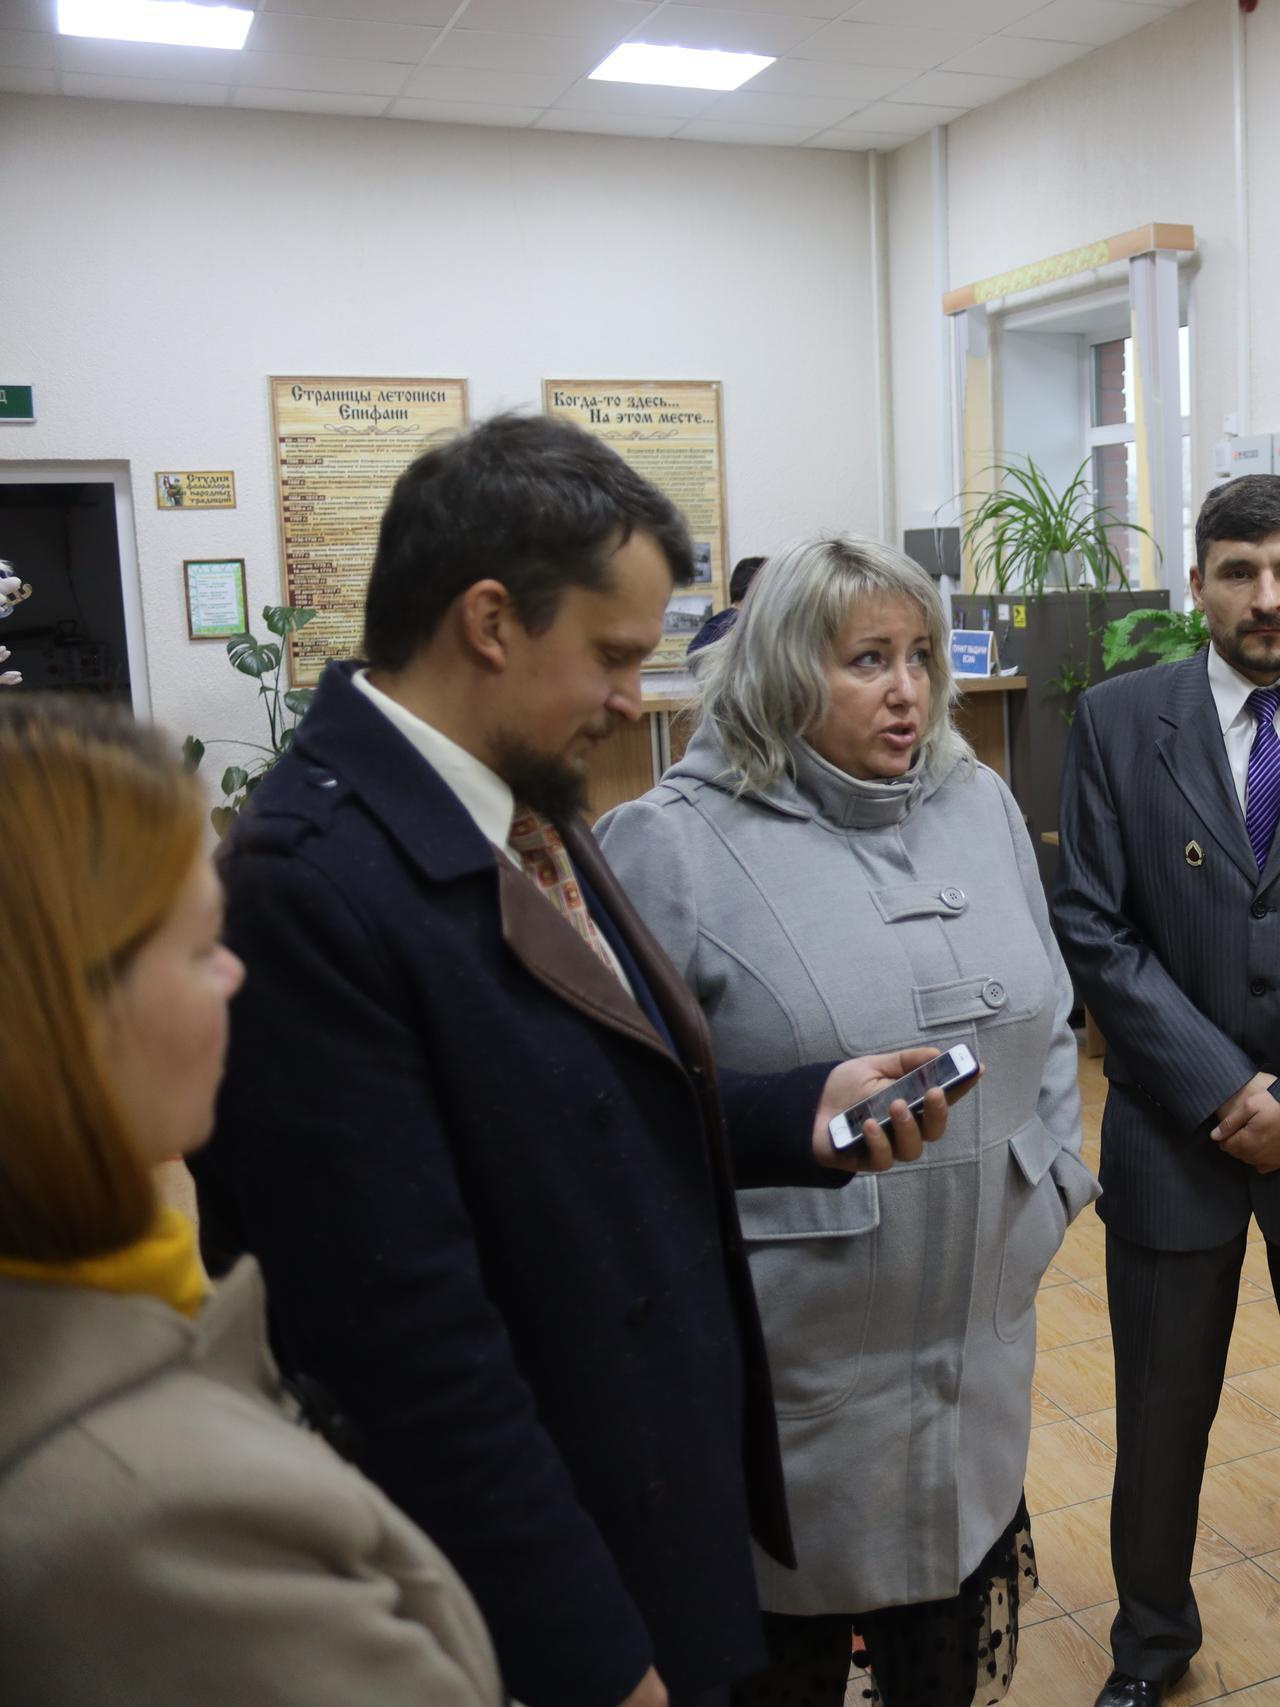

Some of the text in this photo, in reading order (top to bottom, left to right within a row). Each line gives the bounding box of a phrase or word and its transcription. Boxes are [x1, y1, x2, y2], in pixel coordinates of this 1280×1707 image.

[291, 384, 446, 406] Страницы летописи
[553, 391, 622, 409] Когда-то
[338, 403, 408, 424] Епифани
[589, 409, 611, 424] На
[616, 412, 653, 424] этом
[186, 474, 229, 483] Студия
